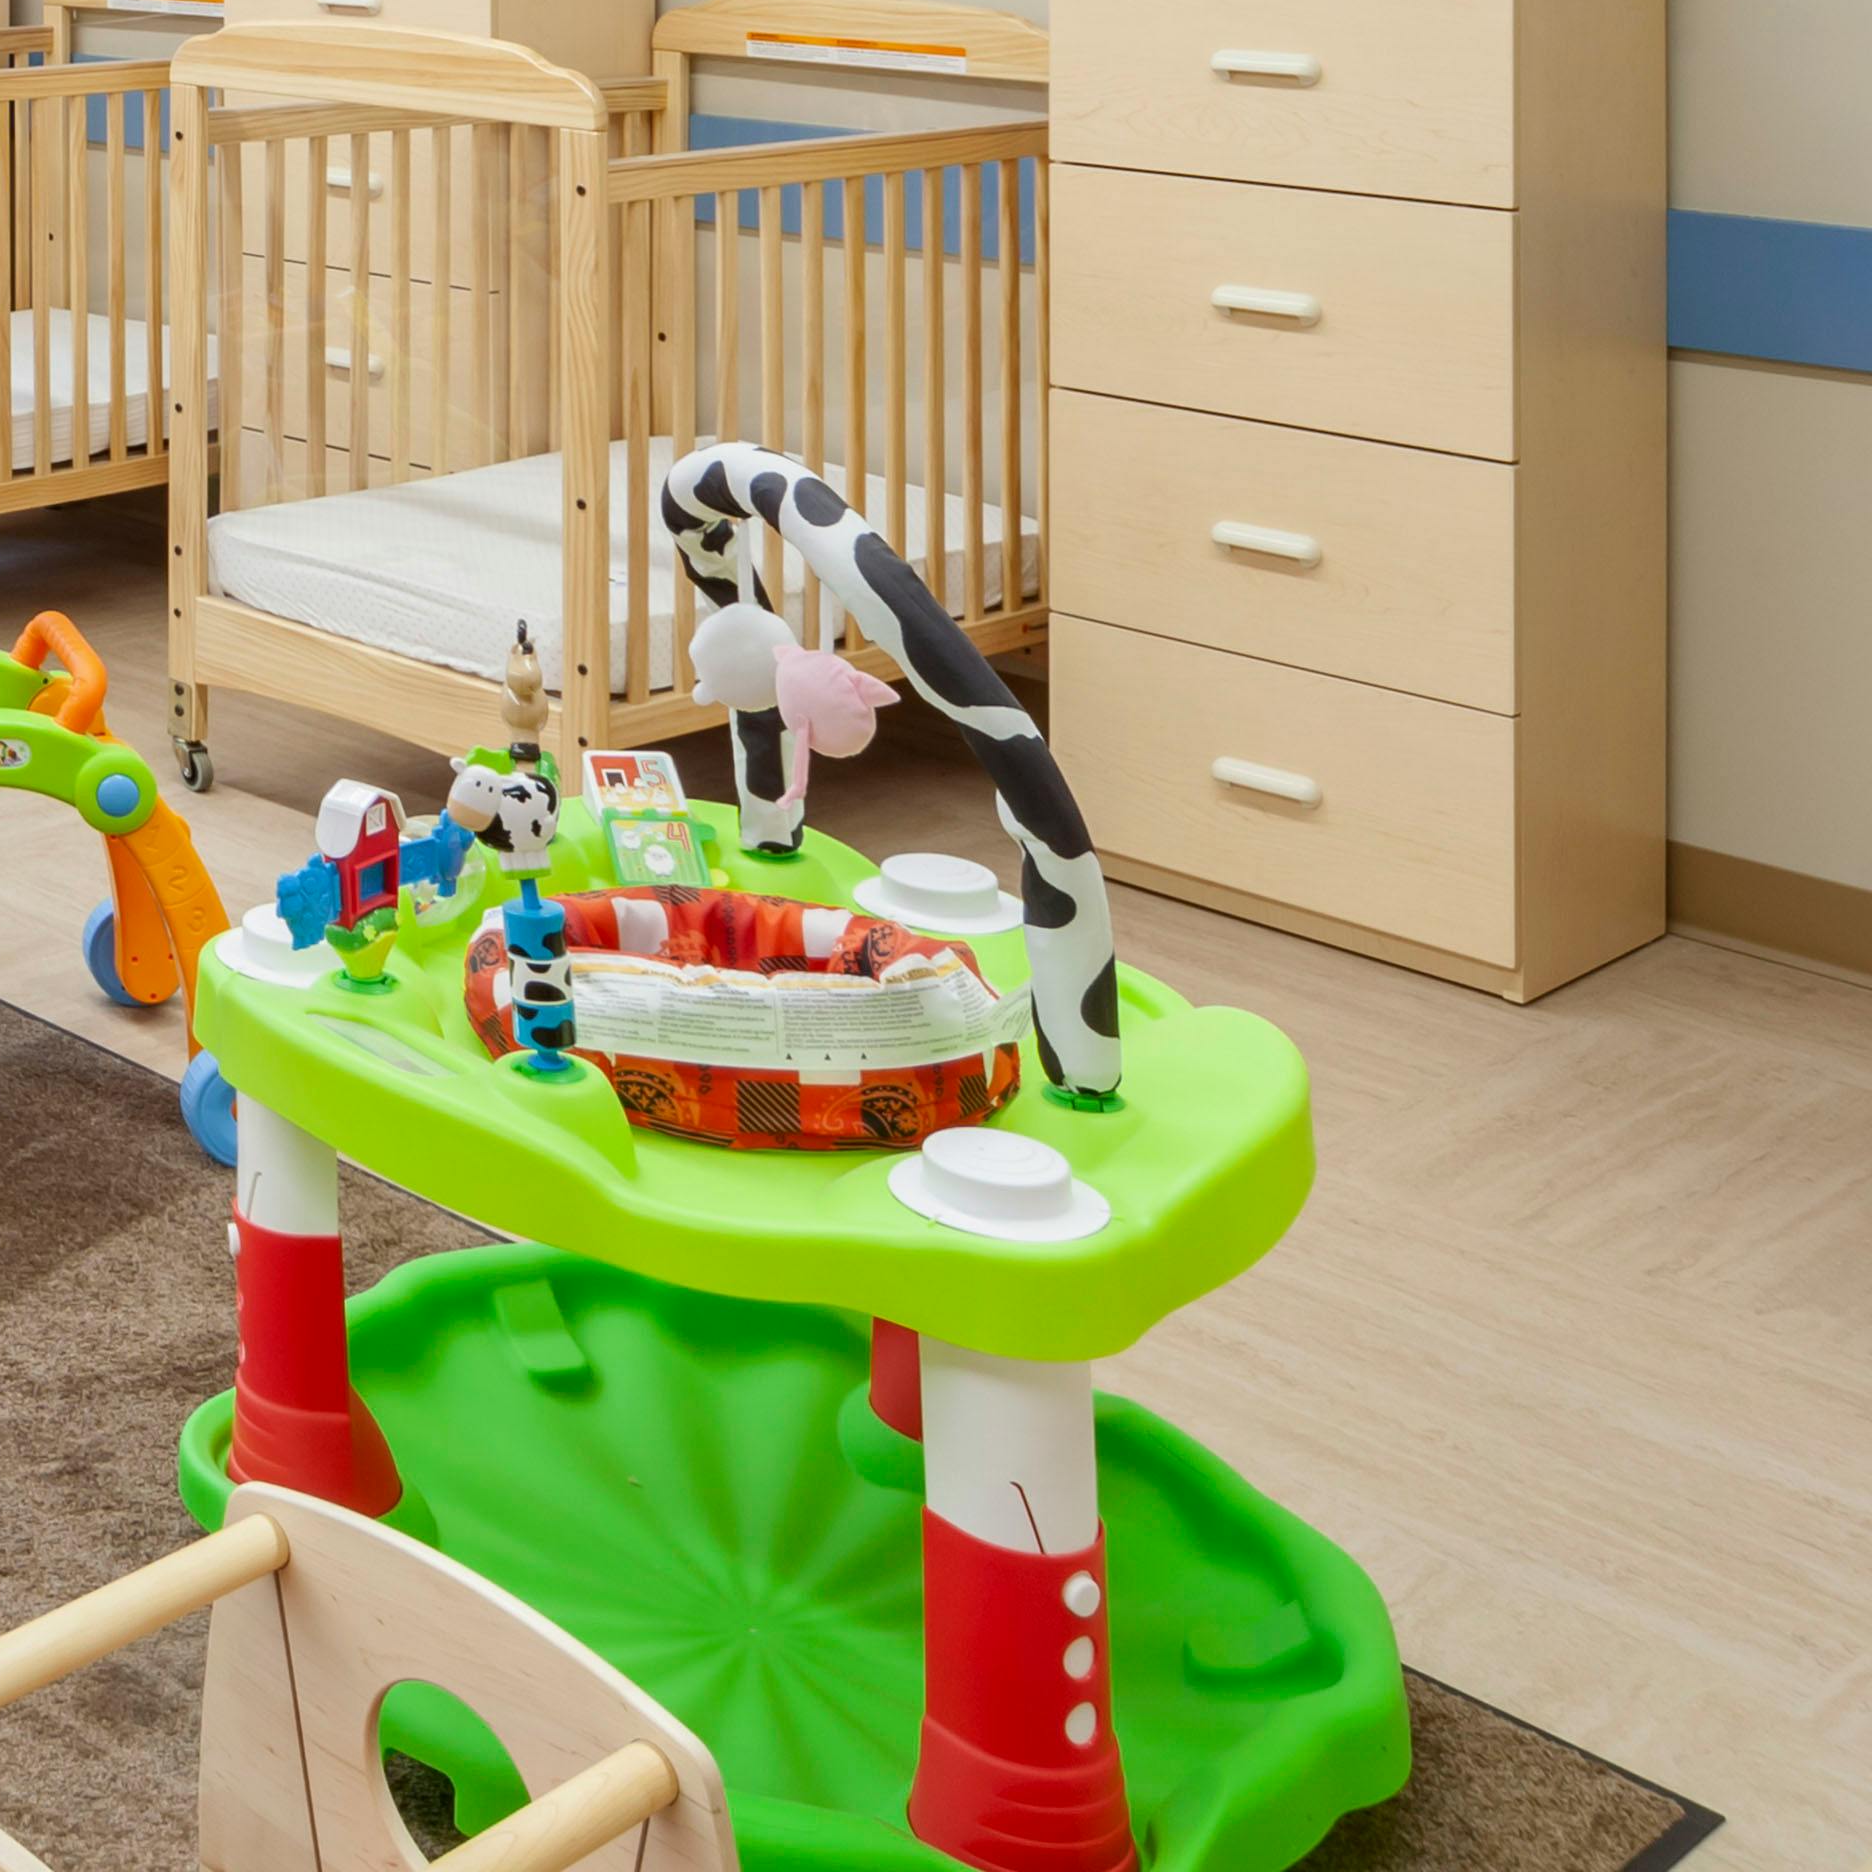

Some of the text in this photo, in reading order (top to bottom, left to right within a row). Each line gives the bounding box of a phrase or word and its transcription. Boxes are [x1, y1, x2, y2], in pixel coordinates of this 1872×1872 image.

[641, 759, 668, 788] 5
[666, 822, 693, 853] 4
[167, 864, 189, 893] 2
[186, 905, 208, 935] 3
